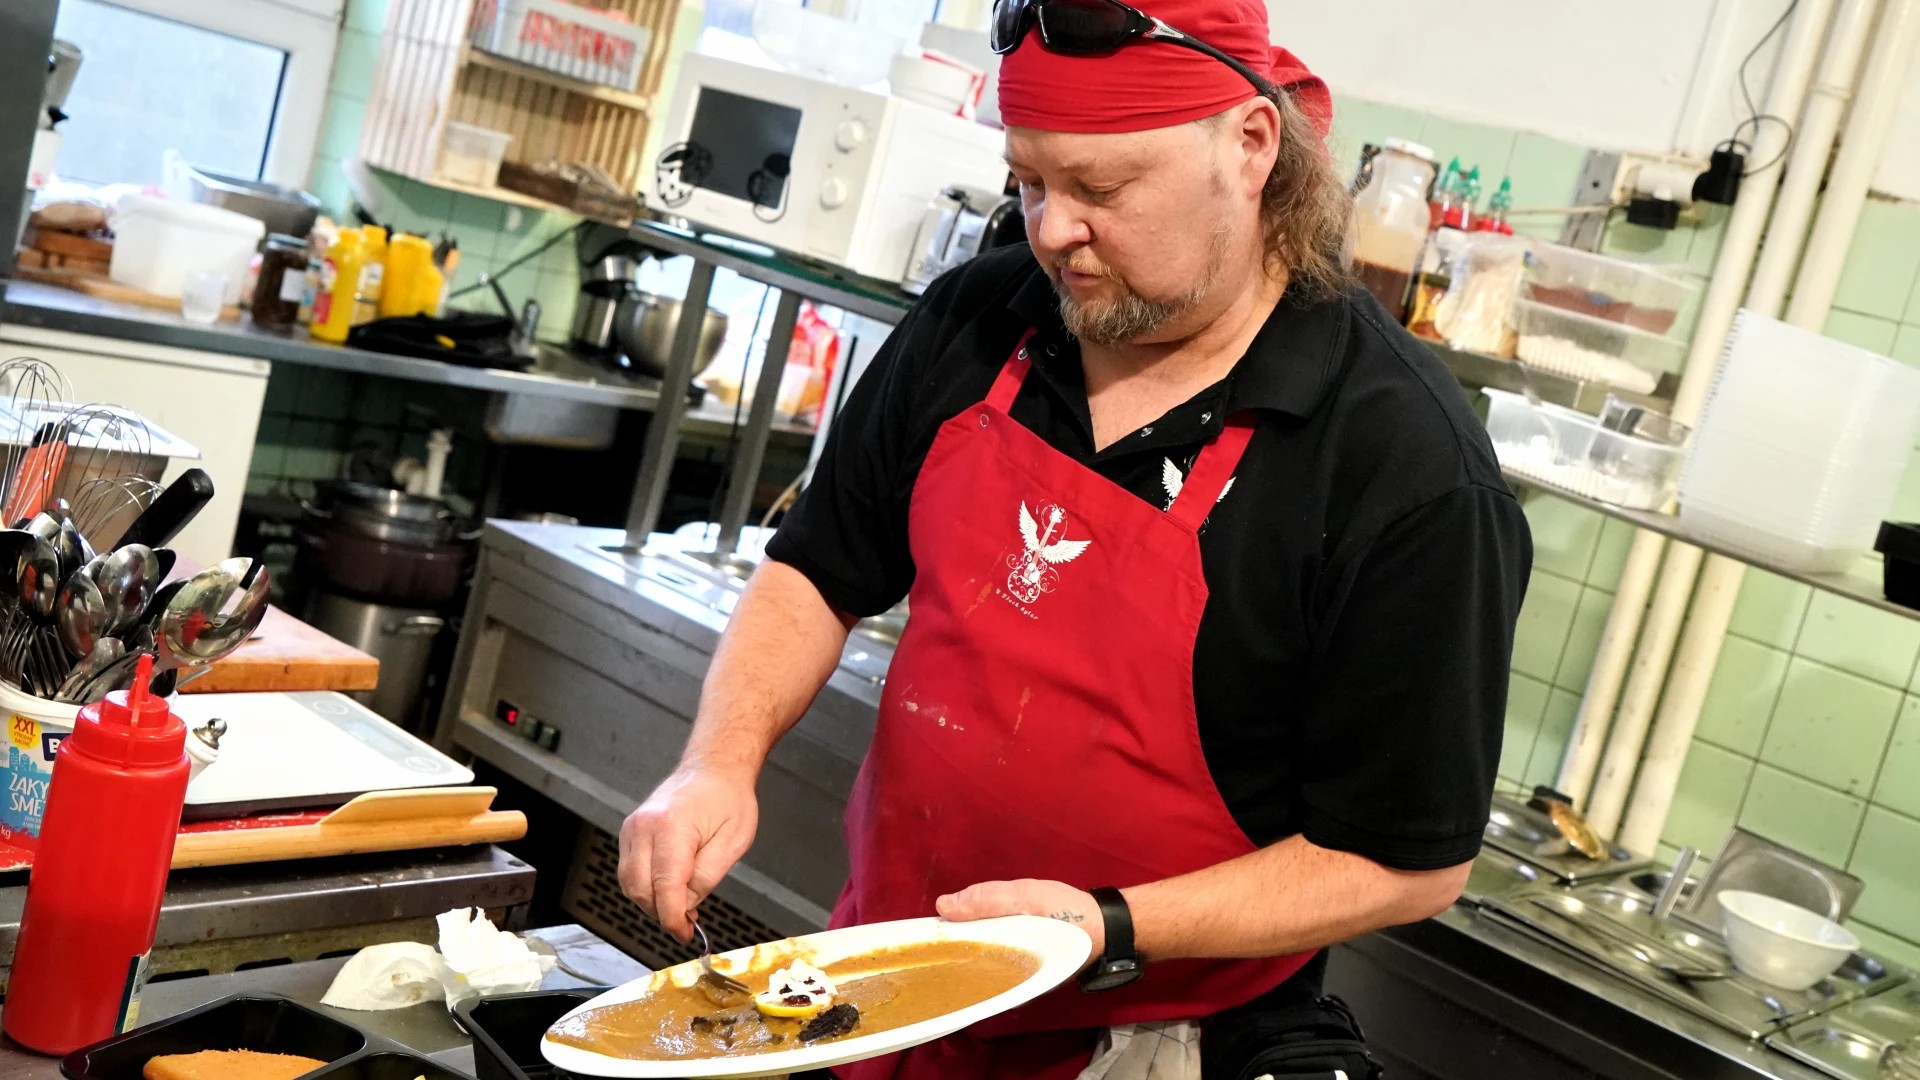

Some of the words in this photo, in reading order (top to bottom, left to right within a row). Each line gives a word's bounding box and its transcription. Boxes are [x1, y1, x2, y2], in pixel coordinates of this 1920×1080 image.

[14, 716, 36, 737] XXL
[9, 792, 47, 817] SME
[1, 825, 11, 840] kg
